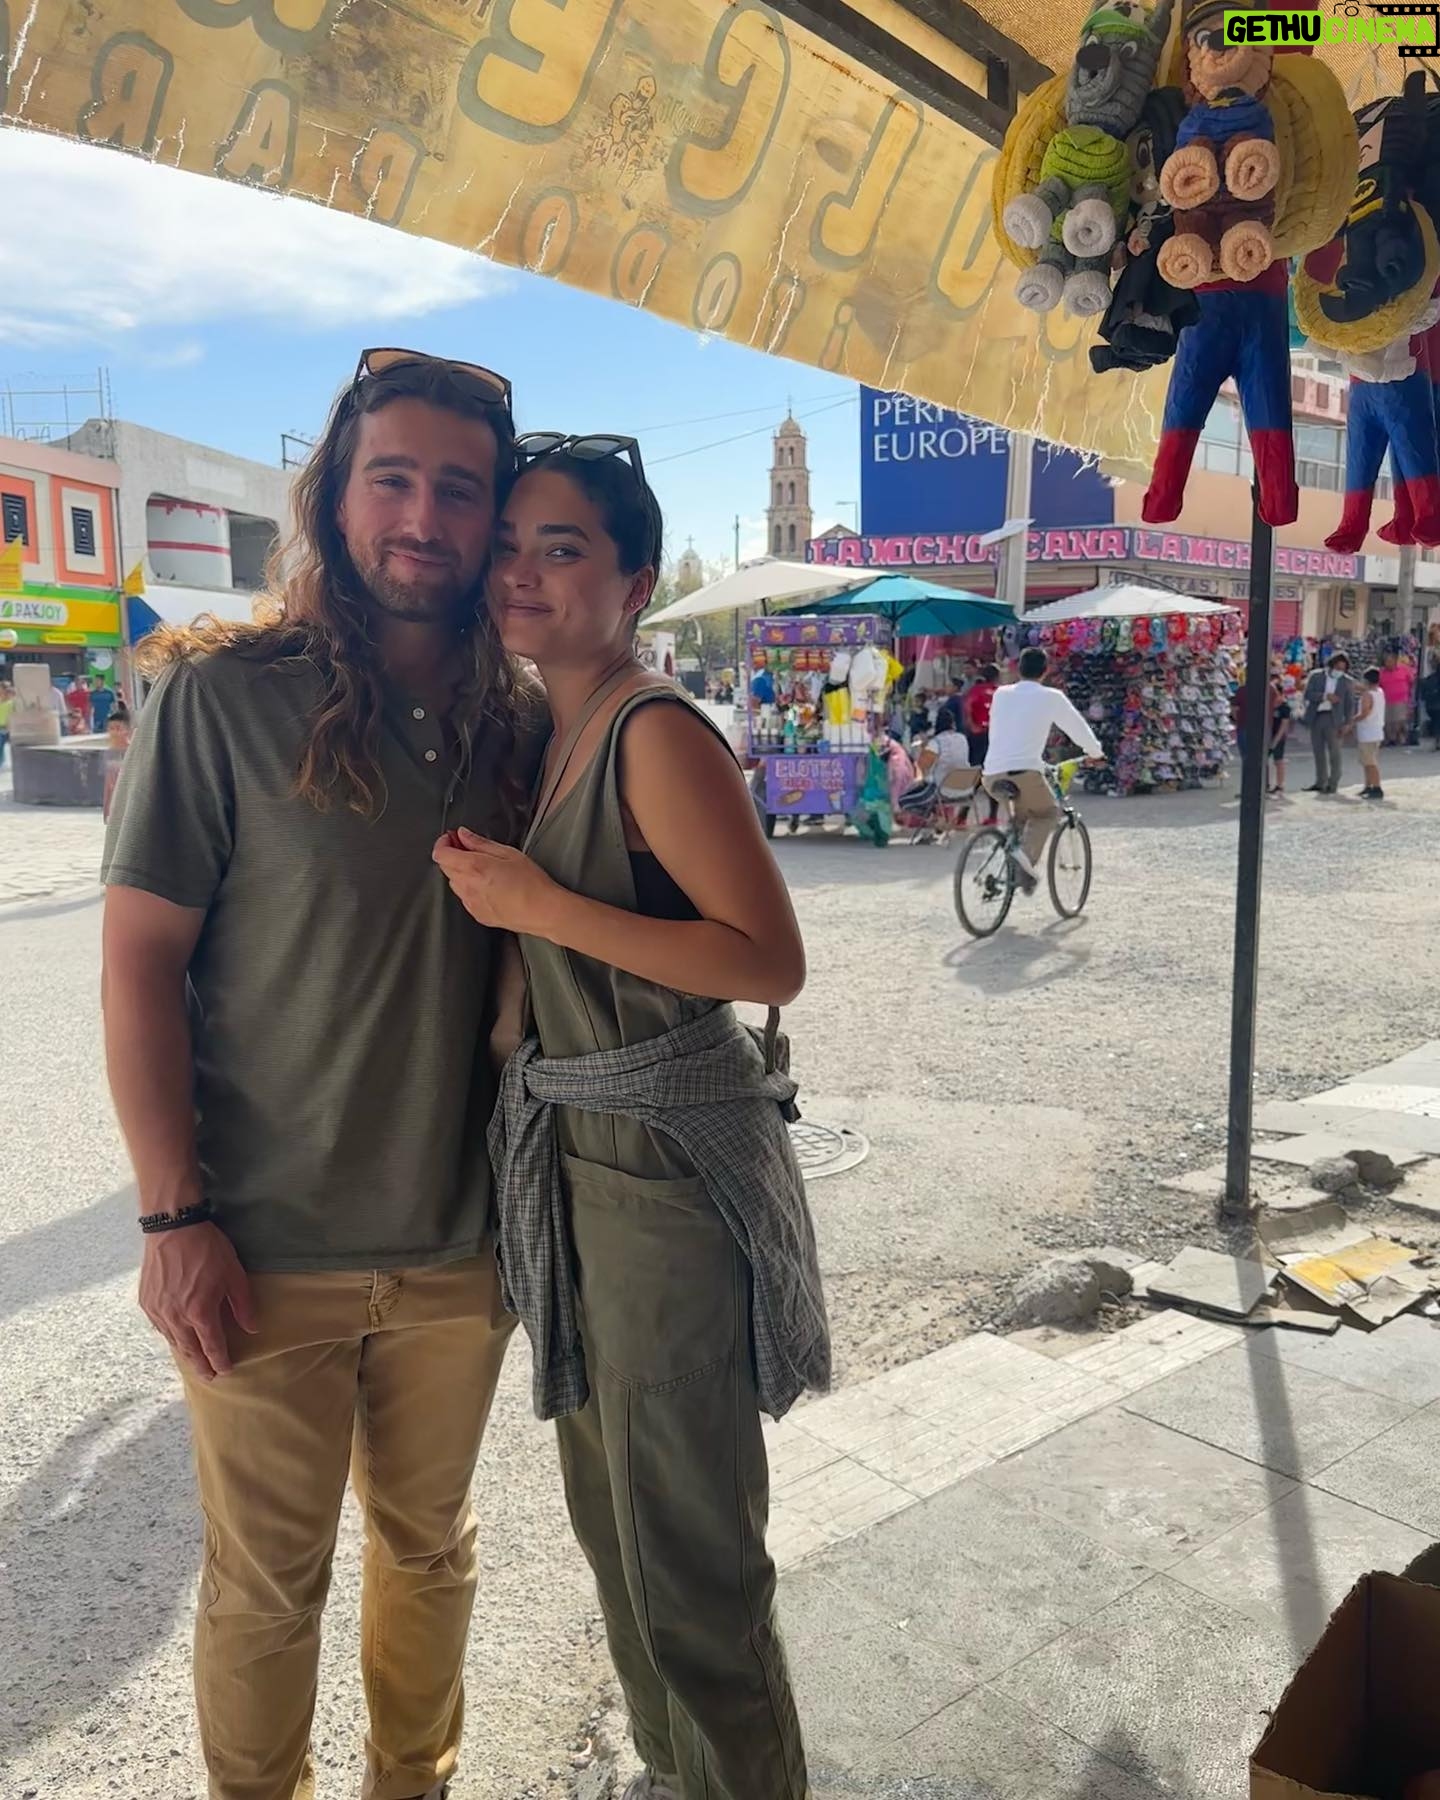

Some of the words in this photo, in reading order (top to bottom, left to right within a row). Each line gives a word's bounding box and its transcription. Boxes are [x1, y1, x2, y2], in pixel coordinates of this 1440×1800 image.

[873, 426, 1048, 463] EUROPE
[811, 537, 866, 567] LA
[867, 530, 1127, 566] MICHOCANA
[1135, 531, 1186, 562] LA
[1186, 537, 1357, 580] MICHACANA
